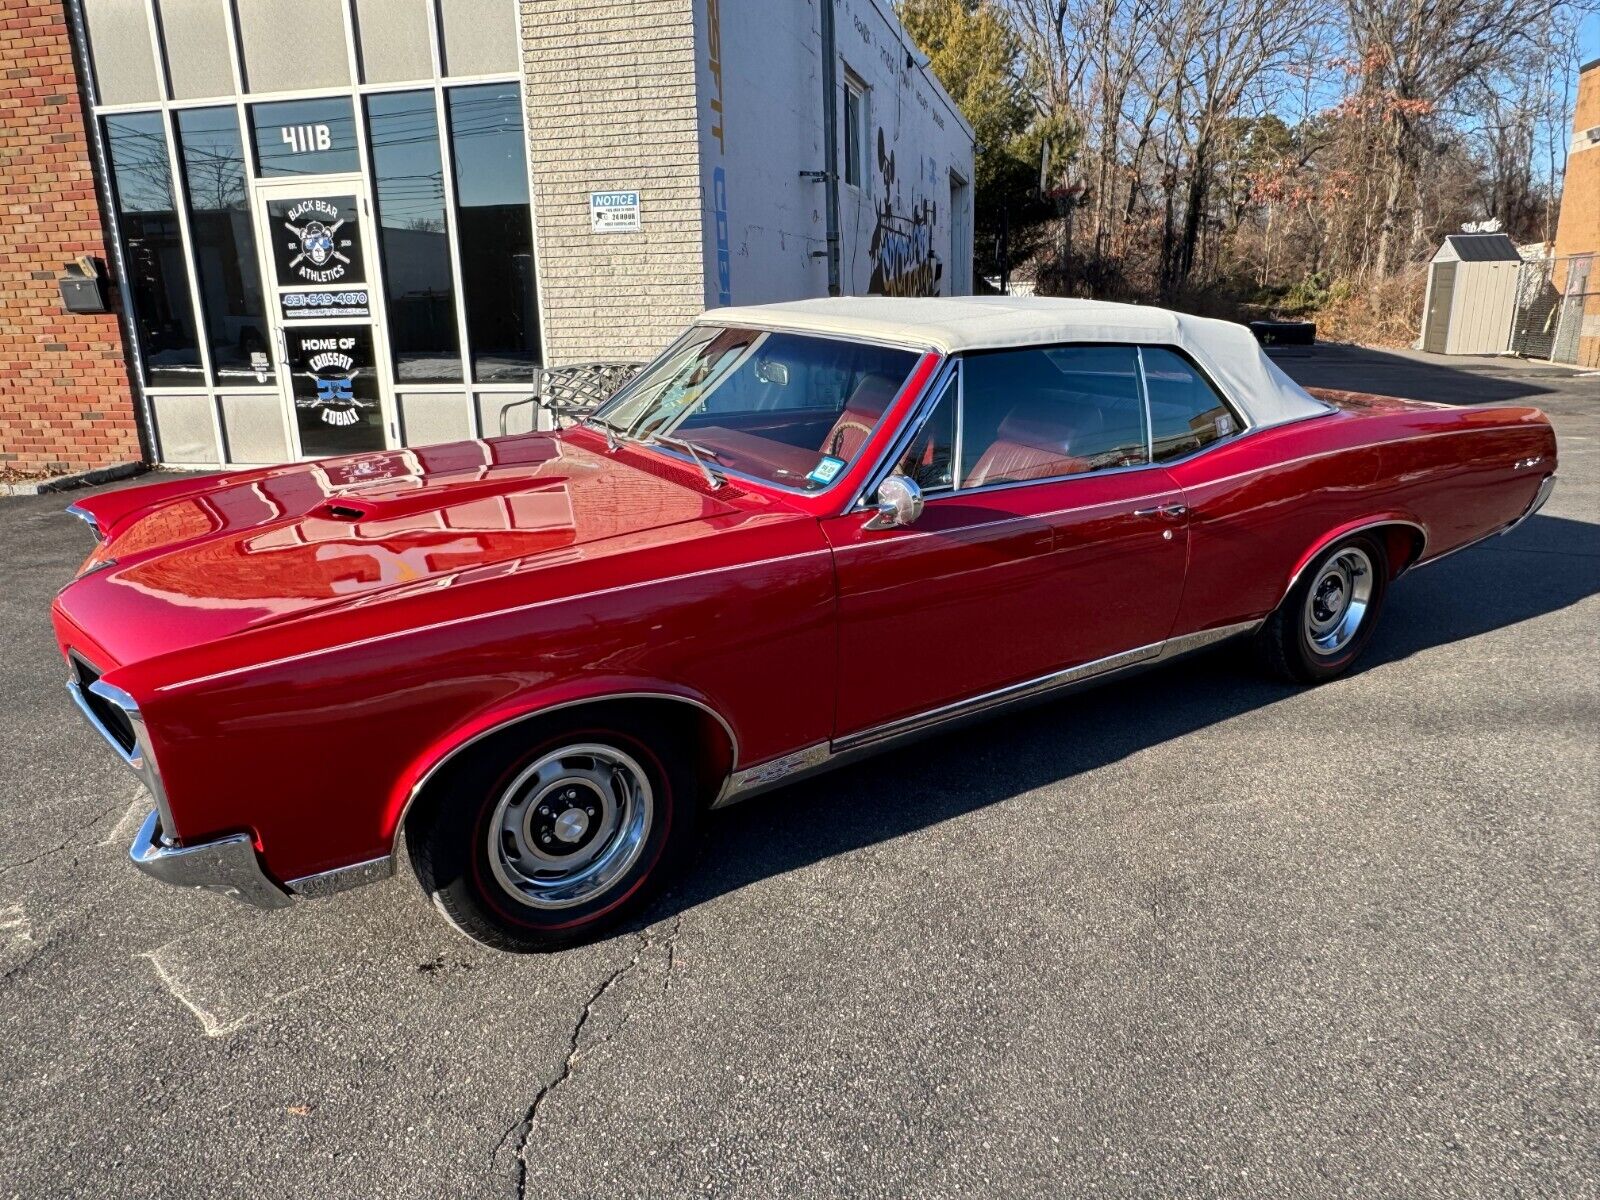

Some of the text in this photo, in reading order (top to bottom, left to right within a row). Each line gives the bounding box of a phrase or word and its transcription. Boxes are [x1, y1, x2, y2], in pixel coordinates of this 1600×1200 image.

[282, 124, 331, 152] 411B
[595, 195, 635, 206] NOTICE
[288, 199, 338, 222] BLACK BEAR
[299, 264, 345, 282] ATHLETICS
[301, 338, 356, 351] HOME OF
[309, 352, 354, 372] CROSSFIT
[321, 407, 360, 426] COBALT
